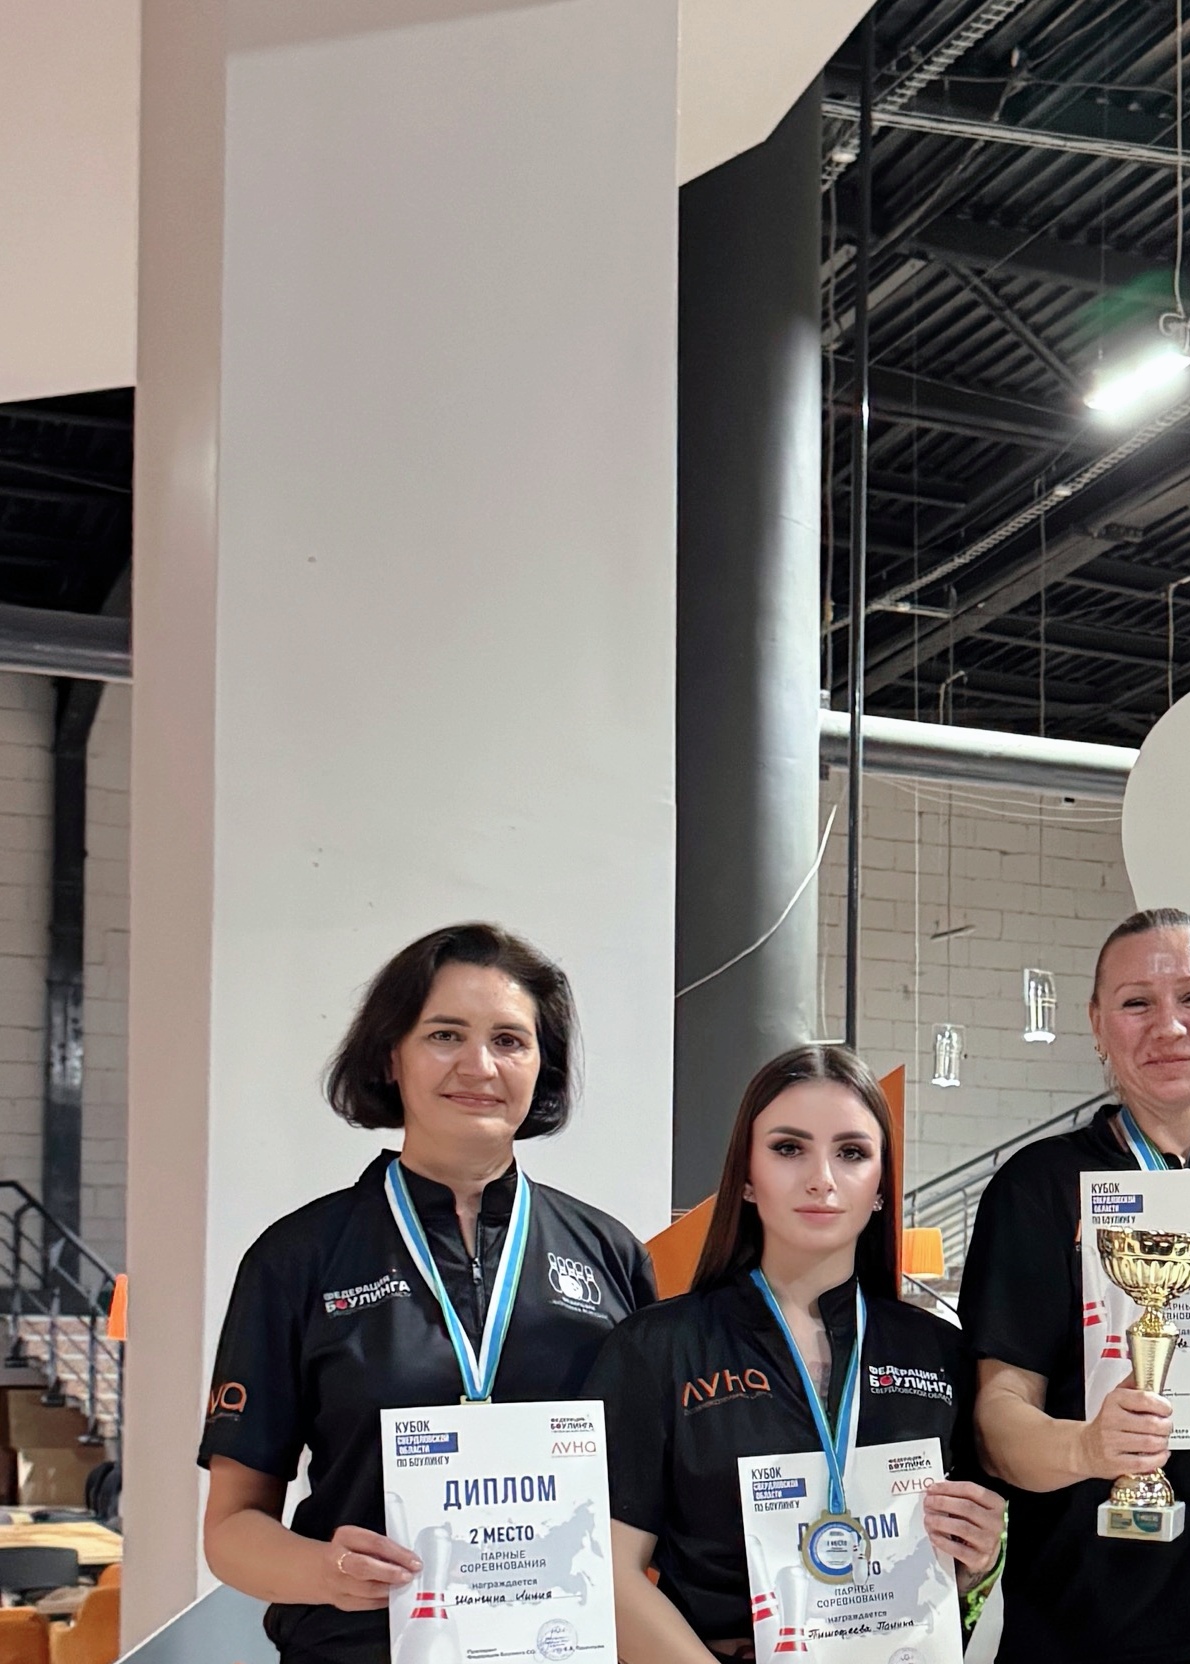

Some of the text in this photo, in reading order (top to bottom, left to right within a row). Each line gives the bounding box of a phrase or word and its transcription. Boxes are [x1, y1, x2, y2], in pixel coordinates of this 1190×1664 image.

[1091, 1183, 1120, 1194] КУБОК
[869, 1365, 938, 1381] ФЕДЕРАЦИЯ
[869, 1374, 953, 1399] БОУЛИНГА
[395, 1420, 430, 1433] КУБОК
[397, 1456, 450, 1467] ПО БОУЛИНГУ
[752, 1467, 782, 1479] КУБОК
[444, 1475, 556, 1511] ДИПЛОМ
[470, 1525, 534, 1544] 2 МЕСТО
[481, 1550, 526, 1561] ПАРНЫЕ
[460, 1559, 547, 1573] СОРЕВНОВАНИЯ
[472, 1578, 538, 1590] награждается
[835, 1584, 875, 1596] ПАРНЫЕ
[817, 1592, 894, 1608] СОРЕВНОВАНИЯ
